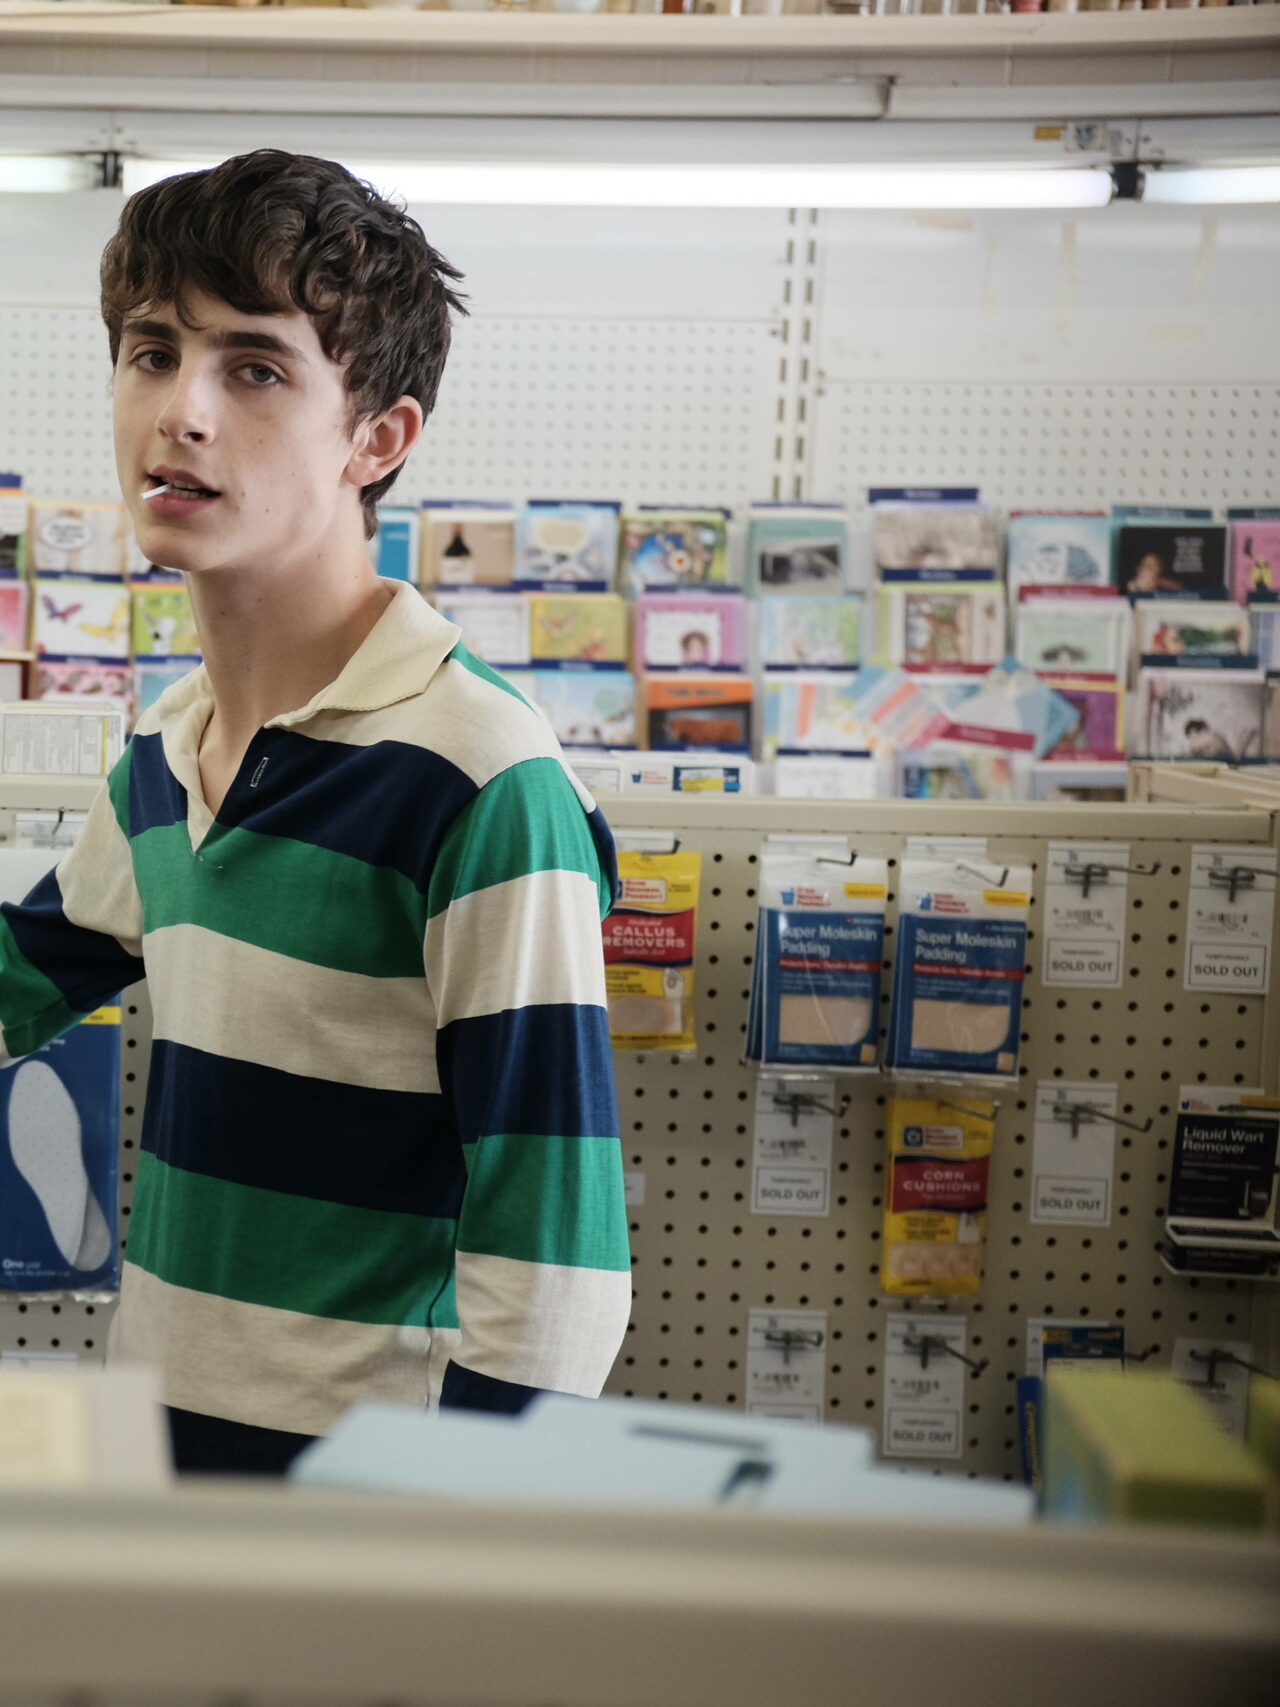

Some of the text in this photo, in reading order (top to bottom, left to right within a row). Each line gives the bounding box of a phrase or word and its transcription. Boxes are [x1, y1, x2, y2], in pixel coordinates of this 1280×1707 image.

[612, 926, 676, 937] CALLUS
[781, 925, 878, 941] Super Moleskin
[603, 936, 687, 948] REMOVERS
[916, 928, 1017, 949] Super Moleskin
[781, 941, 831, 958] Padding
[915, 944, 967, 964] Padding
[1052, 960, 1113, 972] SOLD OUT
[1194, 965, 1259, 977] SOLD OUT
[1184, 1126, 1264, 1143] Liquid Wart
[1183, 1139, 1246, 1154] Remover
[923, 1170, 964, 1181] CORN
[903, 1180, 980, 1192] CUSHIONS
[761, 1188, 820, 1200] SOLD OUT
[1040, 1197, 1101, 1210] SOLD OUT
[2, 1259, 25, 1269] One
[892, 1431, 952, 1442] SOLD OUT
